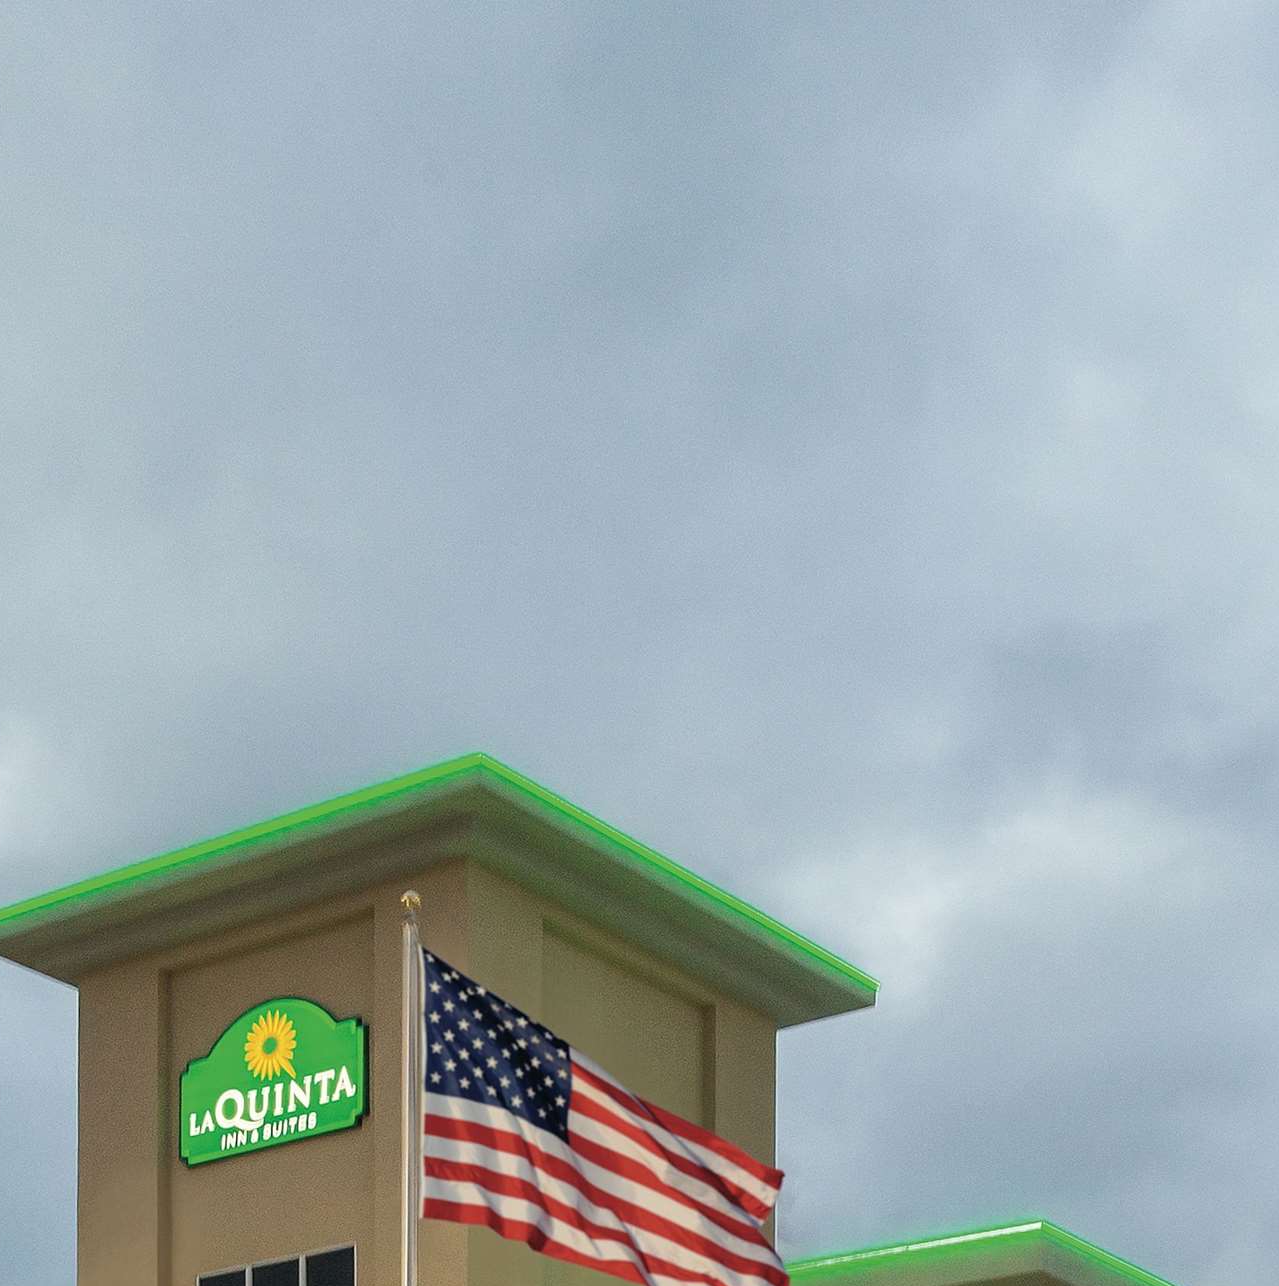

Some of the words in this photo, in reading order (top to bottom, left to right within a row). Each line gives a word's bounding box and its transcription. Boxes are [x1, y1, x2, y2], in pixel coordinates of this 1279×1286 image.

[189, 1110, 215, 1137] LA
[214, 1065, 357, 1131] QUINTA
[221, 1131, 247, 1151] INN
[262, 1111, 317, 1141] SUITES
